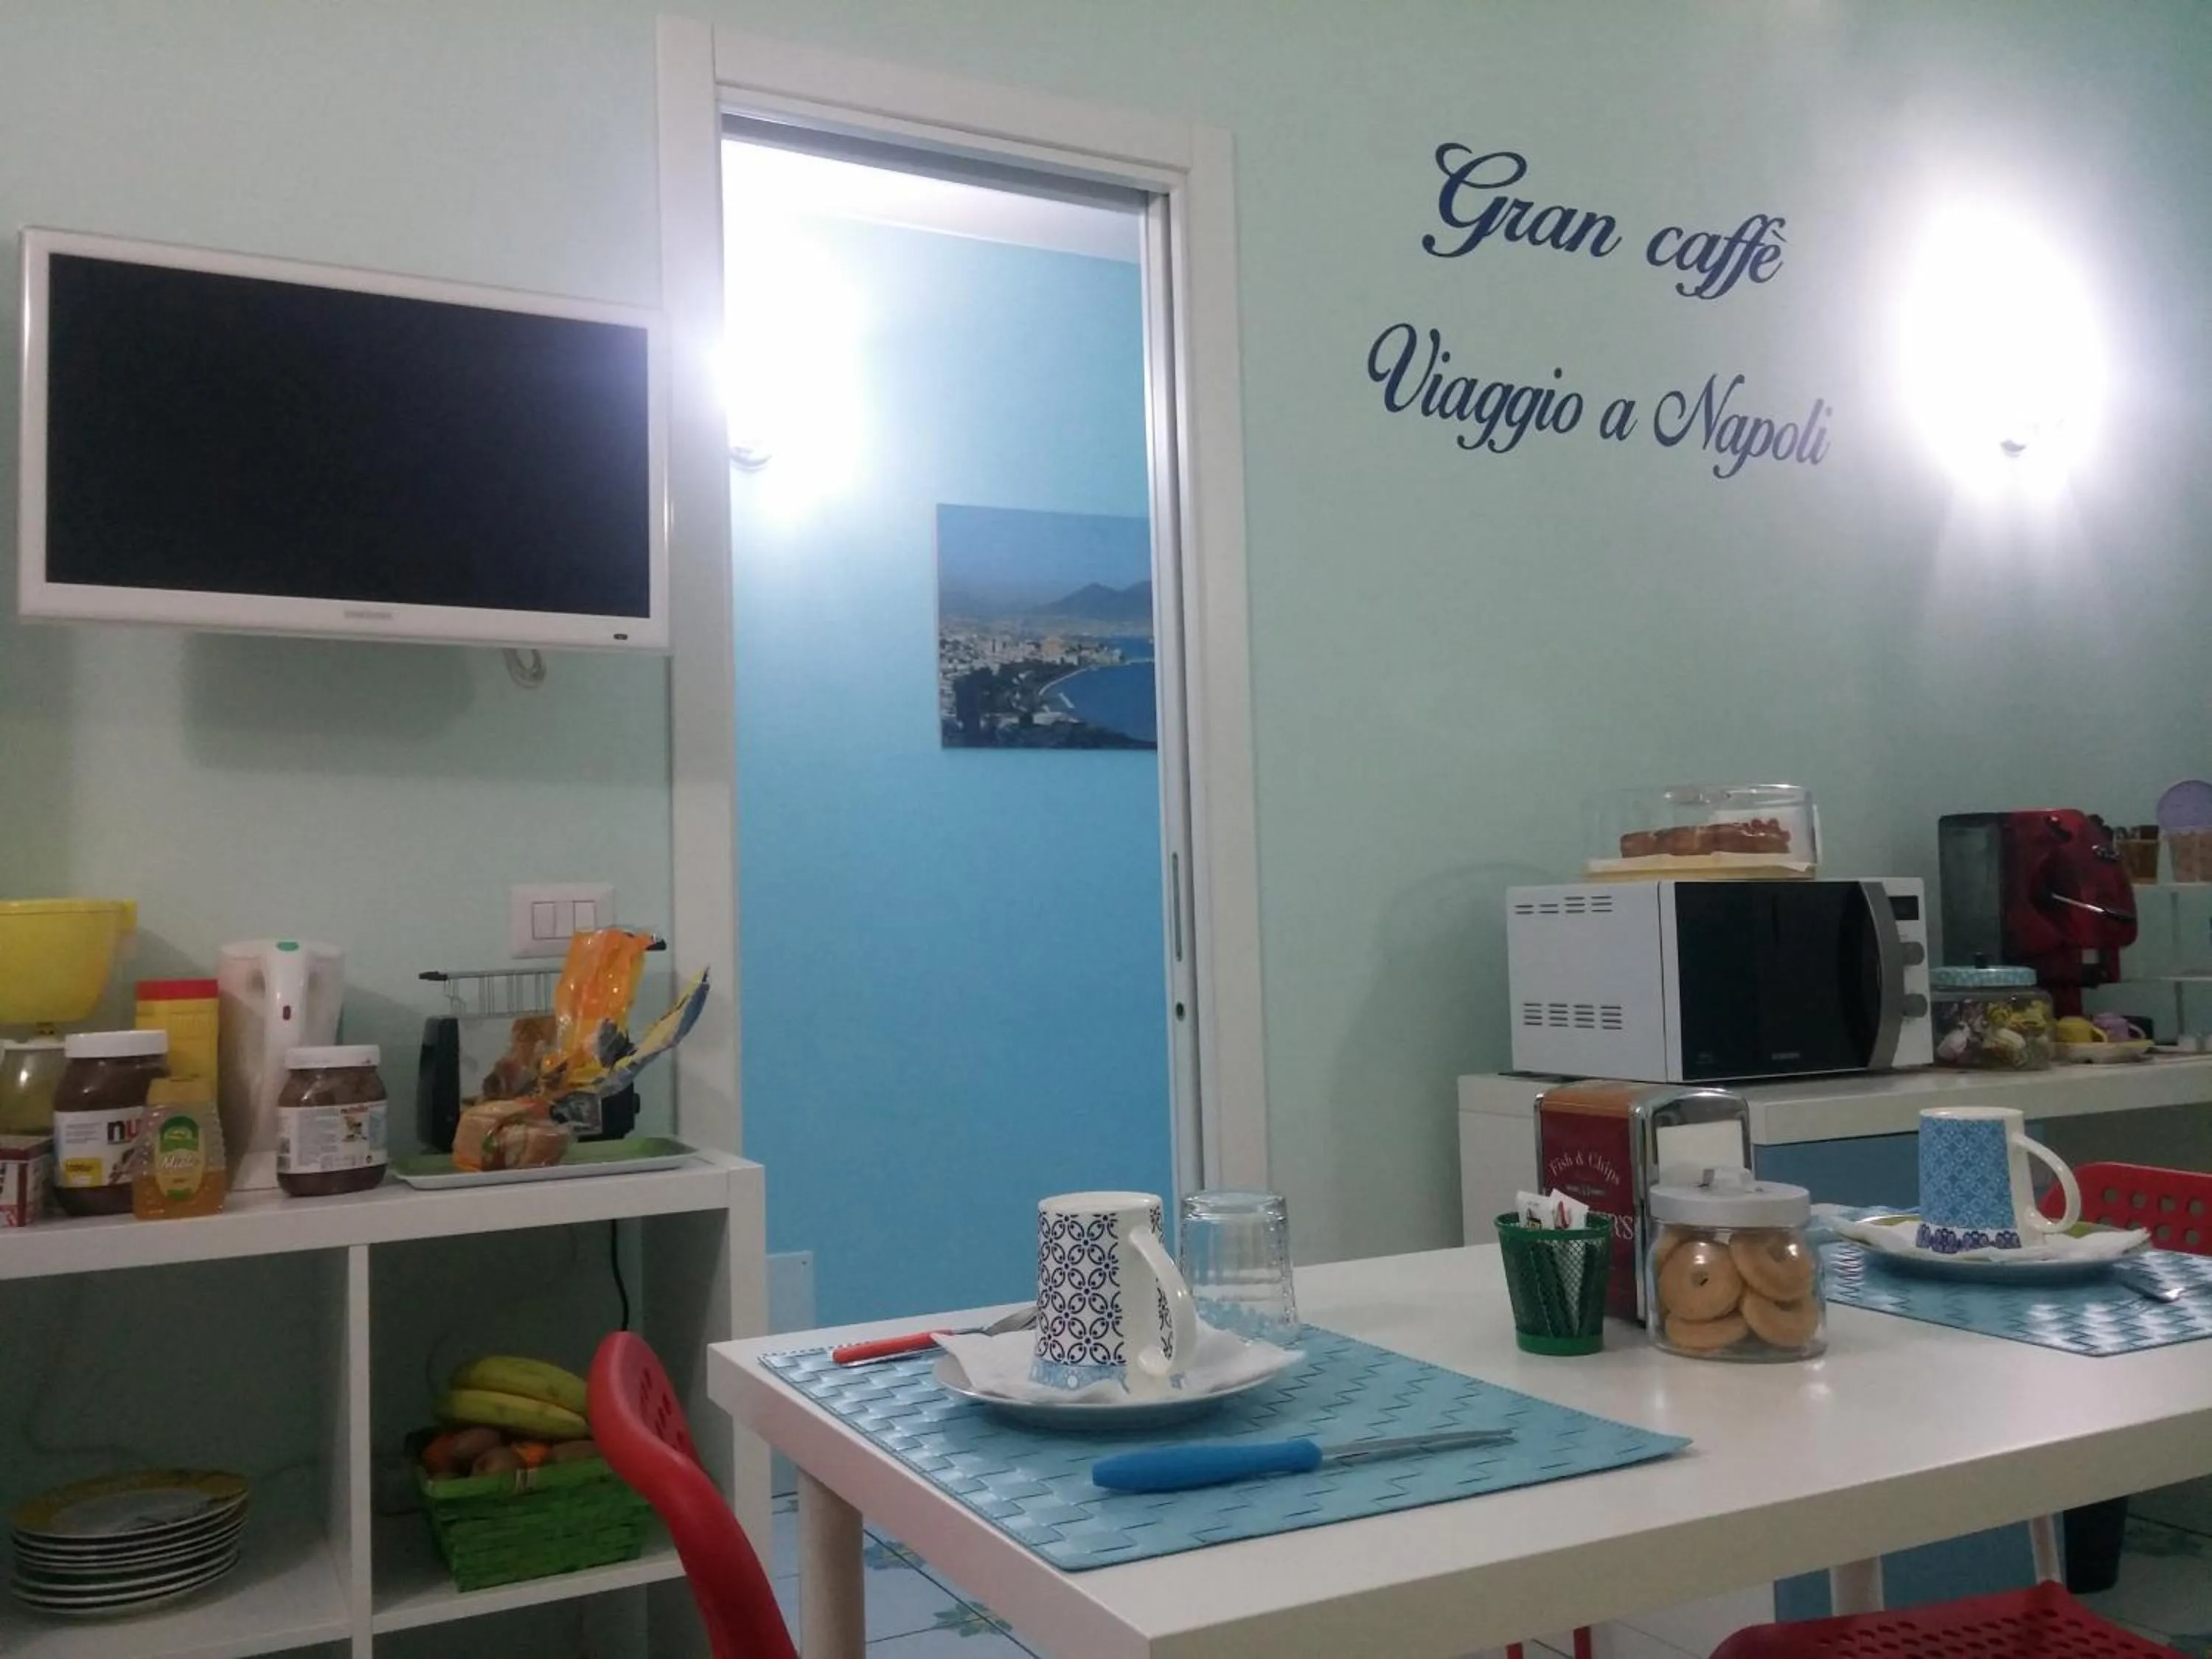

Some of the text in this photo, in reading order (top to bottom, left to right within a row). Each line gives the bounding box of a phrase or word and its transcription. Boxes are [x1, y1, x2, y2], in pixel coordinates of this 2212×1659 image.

[1422, 142, 1787, 300] Gran caffè
[1368, 323, 1833, 479] Viaggio a Napoli
[1549, 1152, 1573, 1177] Fish
[1587, 1152, 1621, 1186] Chips
